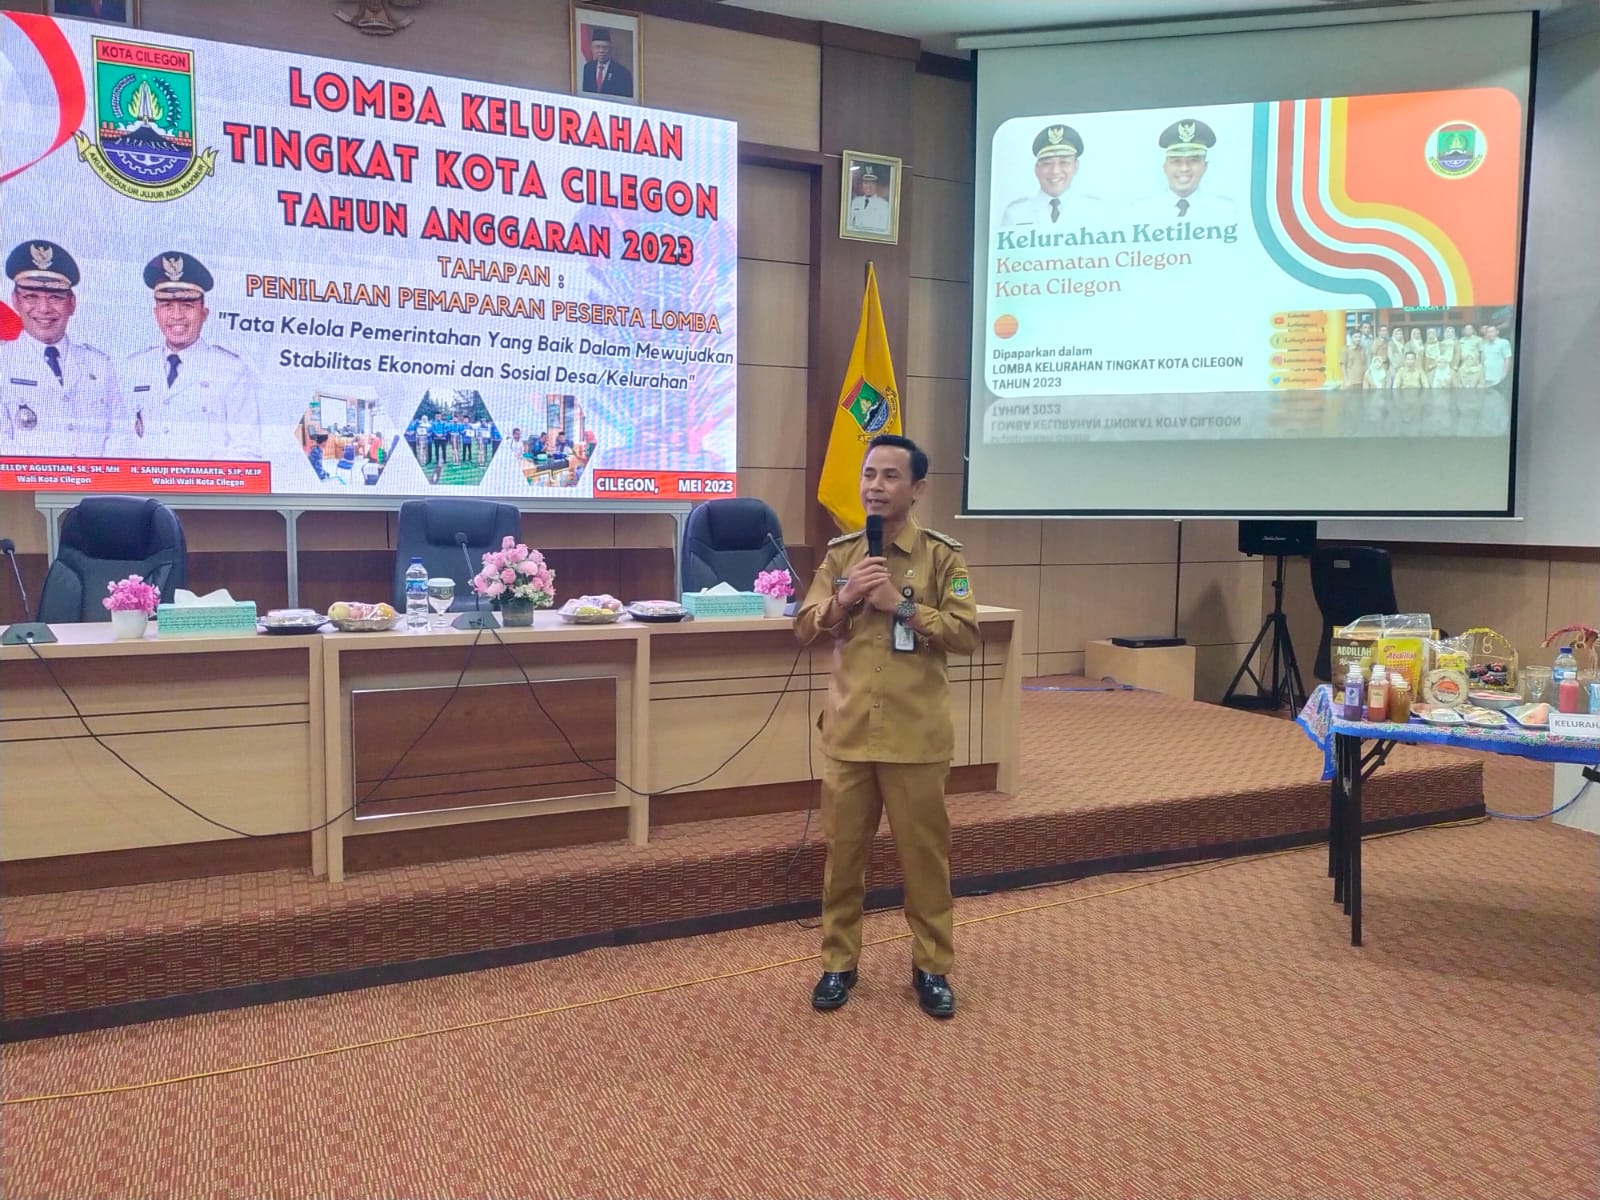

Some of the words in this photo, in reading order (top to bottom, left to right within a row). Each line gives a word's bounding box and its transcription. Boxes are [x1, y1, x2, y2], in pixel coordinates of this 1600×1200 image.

[102, 44, 133, 61] KOTA
[136, 50, 186, 67] CILEGON
[289, 66, 446, 127] LOMBA
[461, 92, 683, 161] KELURAHAN
[223, 121, 419, 183] TINGKAT
[436, 149, 547, 199] KOTA
[561, 166, 718, 220] CILEGON
[277, 190, 407, 238] TAHUN
[420, 206, 610, 258] ANGGARAN
[621, 229, 694, 266] 2023
[996, 226, 1126, 250] Kelurahan
[1132, 221, 1238, 244] Ketileng
[995, 255, 1110, 274] Kecamatan
[1115, 250, 1192, 271] Cilegon
[438, 256, 550, 287] TAHAPAN
[558, 274, 565, 289] :
[994, 281, 1042, 298] Kota
[1046, 277, 1122, 297] Cilegon
[246, 274, 390, 307] PENILAIAN
[398, 287, 545, 319] PEMAPARAN
[552, 301, 645, 329] PESERTA
[651, 310, 721, 334] LOMBA
[218, 311, 275, 333] "Tata
[281, 316, 344, 338] Kelola
[350, 321, 481, 348] Pemerintahan
[488, 332, 532, 354] Yang
[538, 335, 574, 354] Baik
[579, 339, 630, 358] Dalam
[636, 342, 734, 365] Mewujudkan
[992, 347, 1056, 361] Dipaparkan
[1058, 346, 1093, 357] dalam
[279, 349, 372, 372] Stabilitas
[378, 355, 455, 377] Ekonomi
[461, 361, 494, 379] dan
[500, 363, 550, 382] Sosial
[555, 366, 696, 390] Desa/Kelurahan"
[992, 363, 1033, 375] LOMBA
[1034, 360, 1103, 373] KELURAHAN
[1106, 359, 1155, 371] TINGKAT
[1158, 357, 1189, 369] KOTA
[1191, 356, 1244, 369] CILEGON
[992, 379, 1031, 391] TAHUN
[1033, 377, 1062, 389] 2023
[0, 464, 27, 472] ELLDY
[141, 466, 169, 475] SANUJI
[16, 475, 37, 483] Wali
[38, 475, 58, 483] Kota
[60, 475, 91, 485] Cilegon
[152, 477, 174, 485] Wakil
[177, 477, 194, 485] Wali
[216, 478, 245, 487] Cilegon
[596, 477, 659, 494] CILEGON,
[678, 479, 702, 493] MEI
[704, 480, 733, 493] 2023
[1336, 646, 1372, 657] ABDILLAH
[1554, 719, 1600, 729] KELURAH
